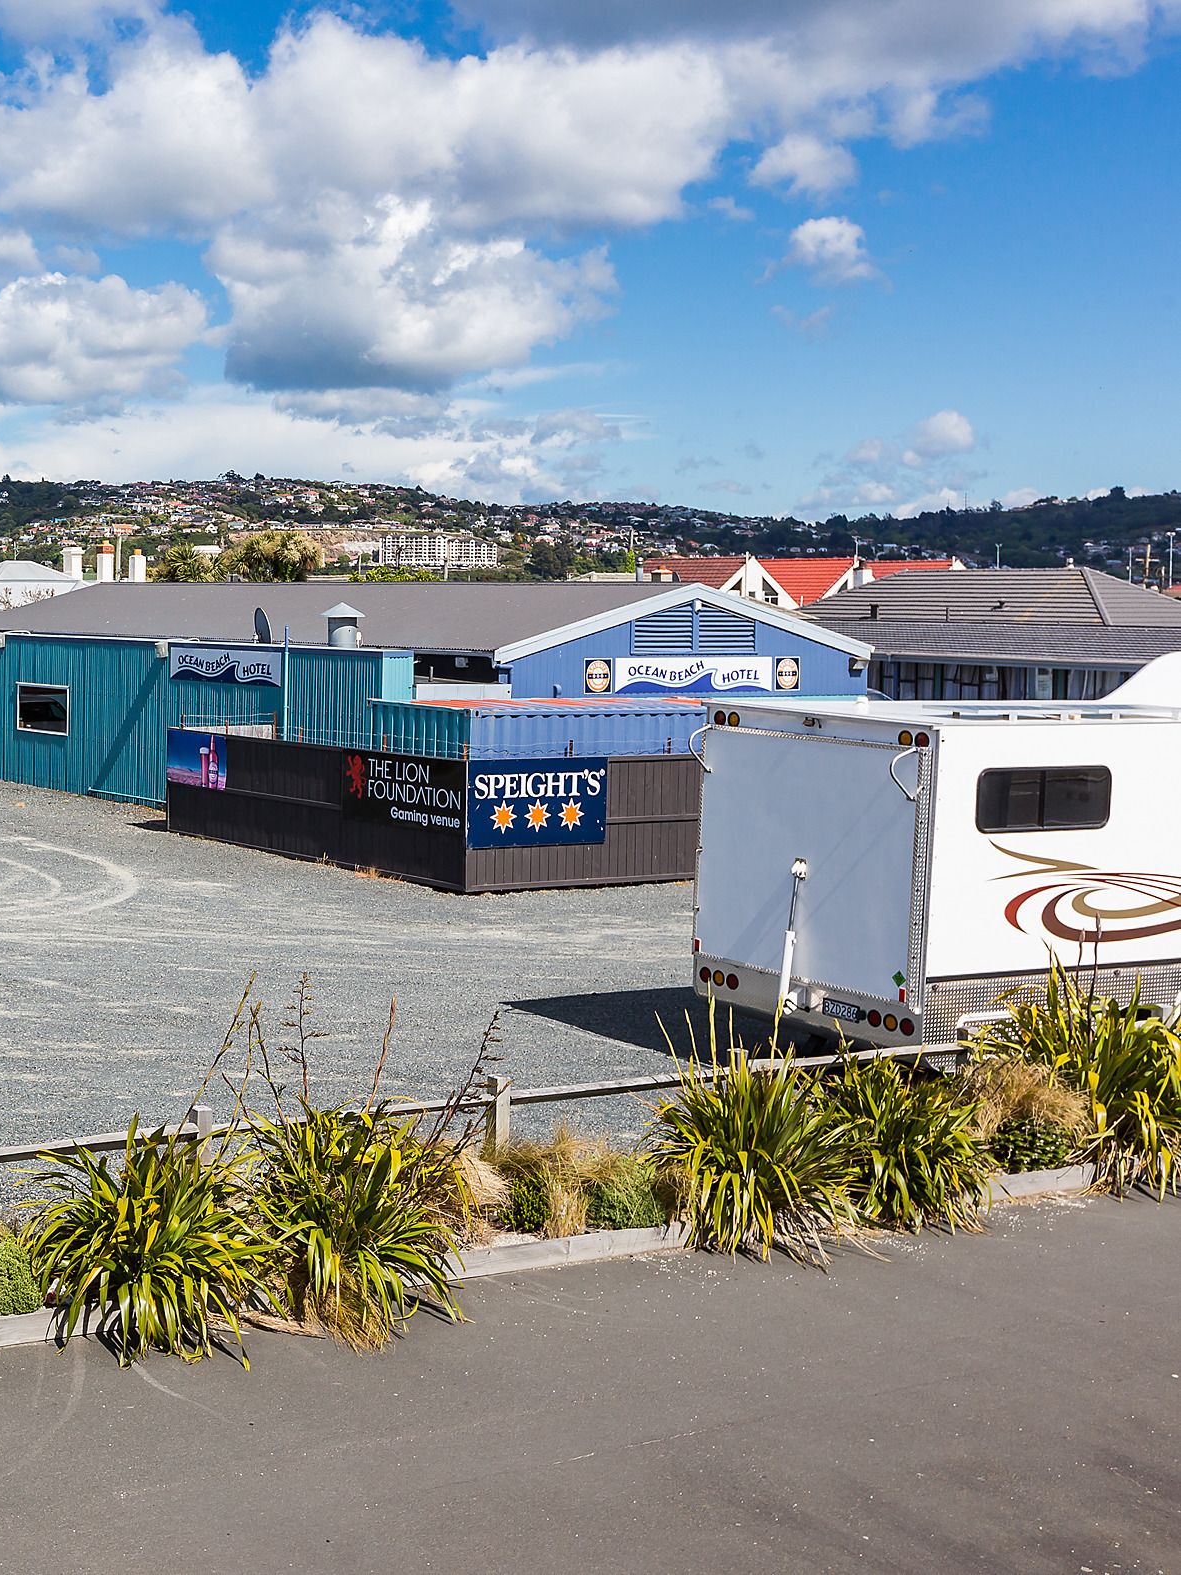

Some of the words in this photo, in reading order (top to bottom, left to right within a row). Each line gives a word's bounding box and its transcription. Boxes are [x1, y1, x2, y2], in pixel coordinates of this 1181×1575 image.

[178, 655, 204, 669] OCEAN
[205, 652, 231, 671] BEACH
[242, 663, 272, 676] HOTEL
[628, 665, 668, 679] OCEAN
[669, 660, 705, 681] BEACH
[722, 669, 760, 683] HOTEL
[368, 758, 393, 779] THE
[395, 761, 430, 784] LION
[367, 779, 461, 811] FOUNDATION
[474, 769, 601, 799] SPEIGHT'S
[390, 806, 428, 826] Gaming
[430, 814, 461, 829] venue
[824, 1001, 858, 1019] BZD286
